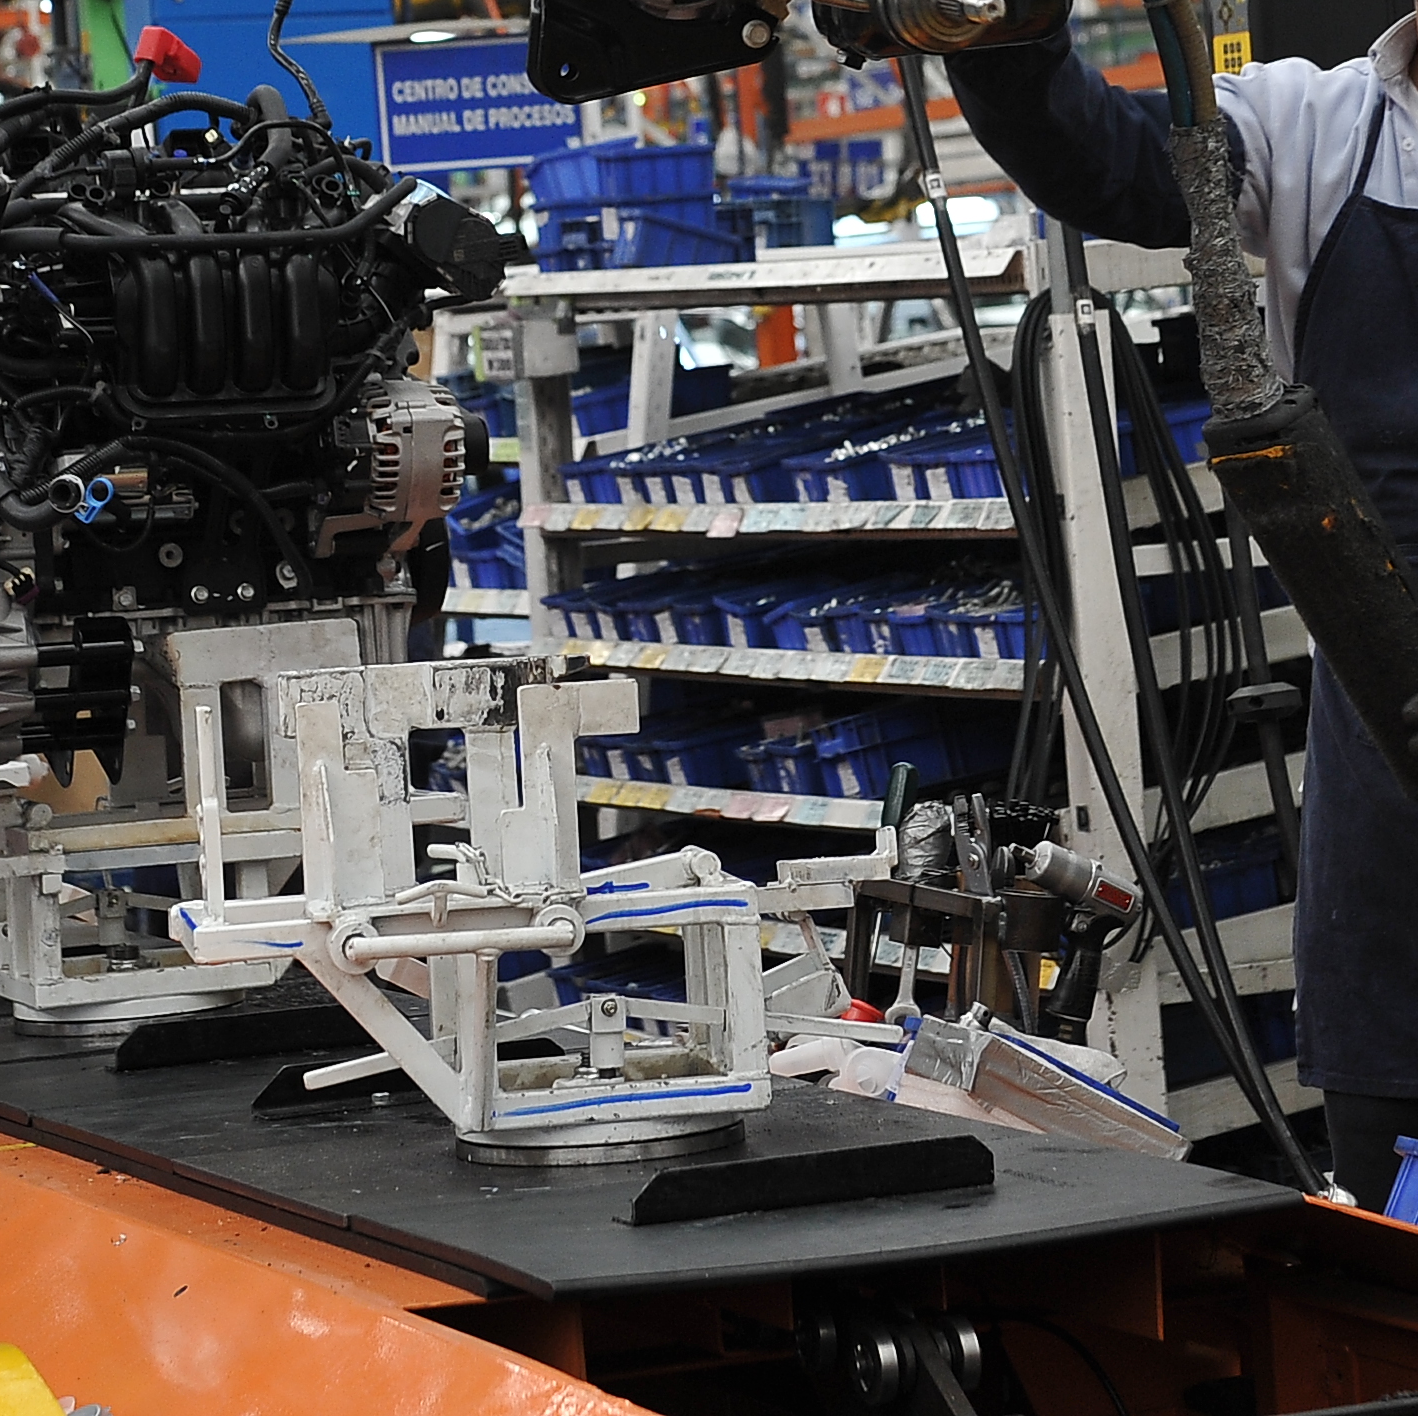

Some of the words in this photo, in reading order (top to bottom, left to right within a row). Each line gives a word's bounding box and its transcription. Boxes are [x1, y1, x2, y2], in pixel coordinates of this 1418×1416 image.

[391, 77, 459, 104] CENTRO
[461, 76, 485, 99] DE
[486, 73, 538, 98] CONS
[392, 111, 461, 137] MANUAL
[463, 108, 487, 132] DE
[488, 103, 576, 130] PROCESOS
